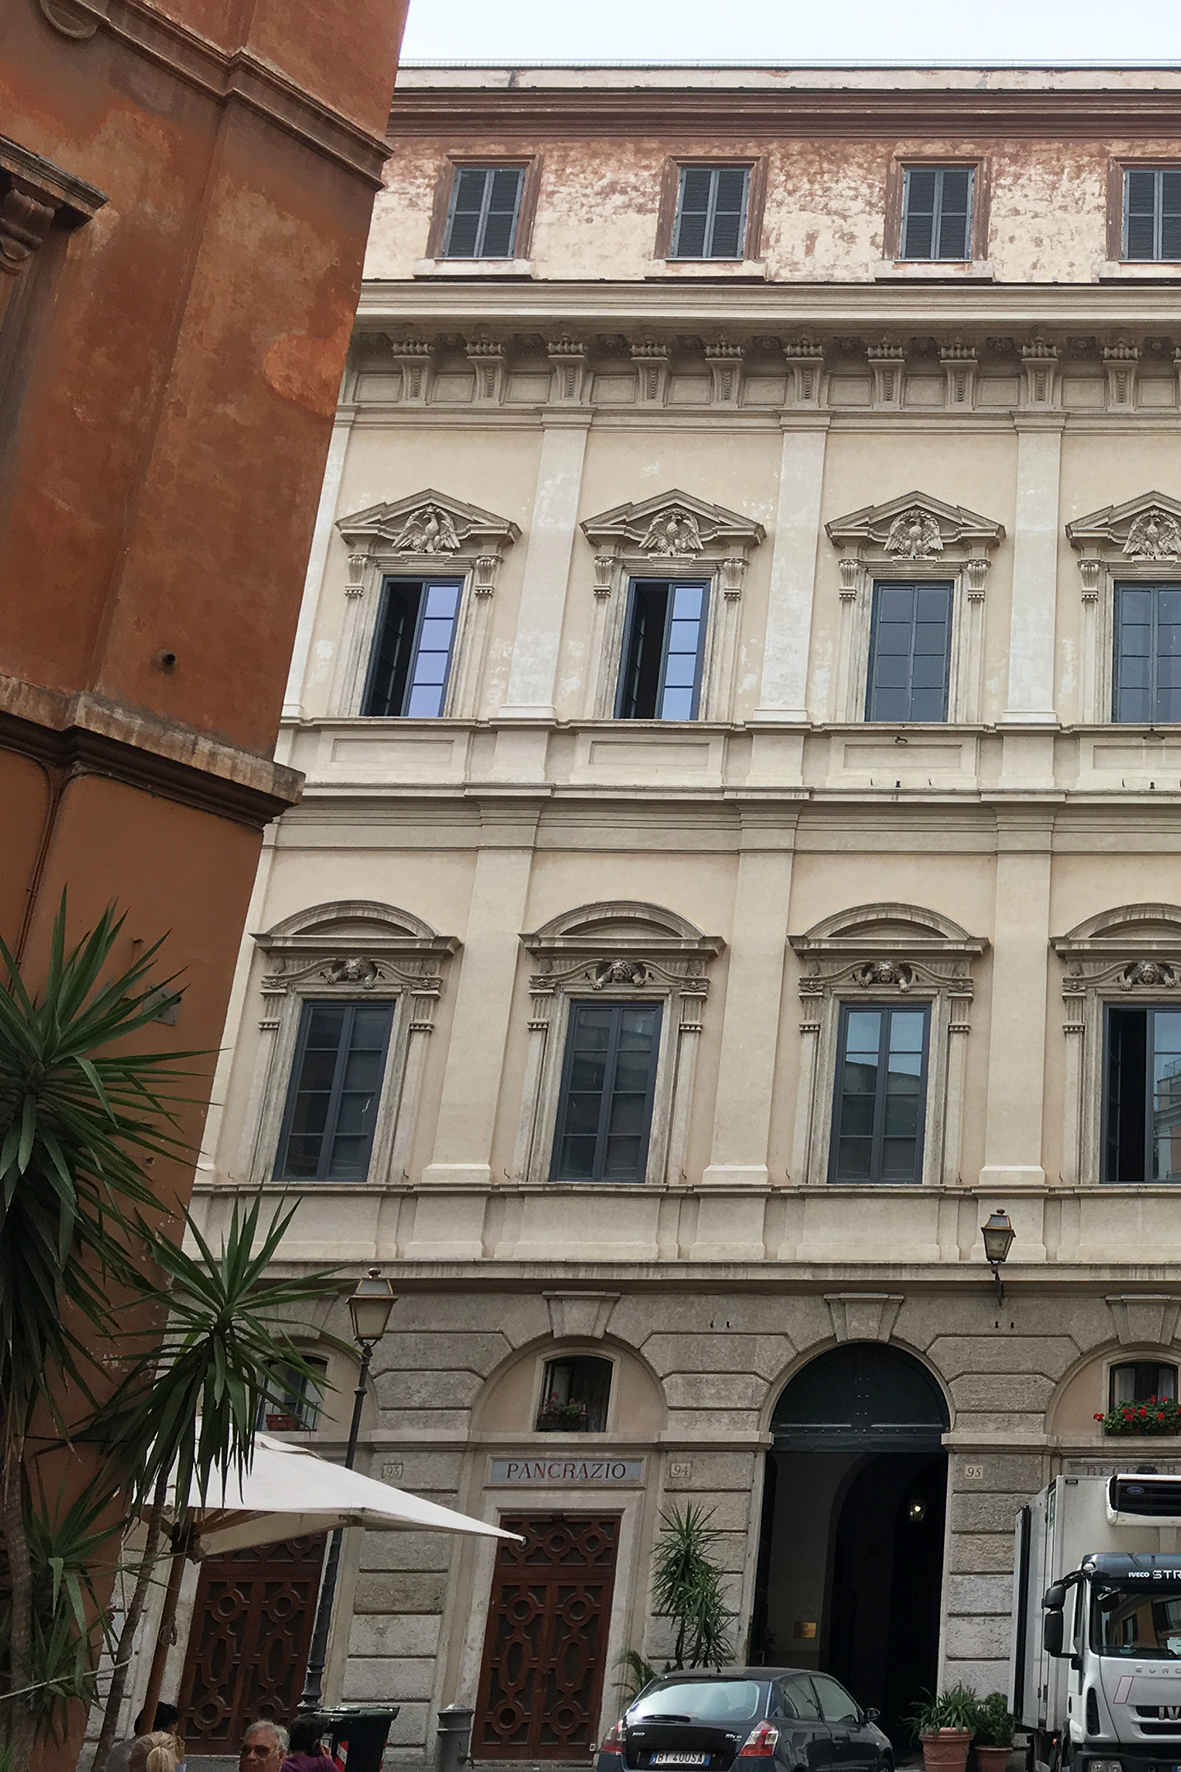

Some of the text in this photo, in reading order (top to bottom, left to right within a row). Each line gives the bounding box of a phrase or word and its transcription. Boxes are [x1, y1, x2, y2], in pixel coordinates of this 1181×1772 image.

[385, 1465, 400, 1477] 93
[506, 1462, 627, 1480] PANCRAZIO
[672, 1464, 689, 1476] 94
[965, 1466, 982, 1478] 95
